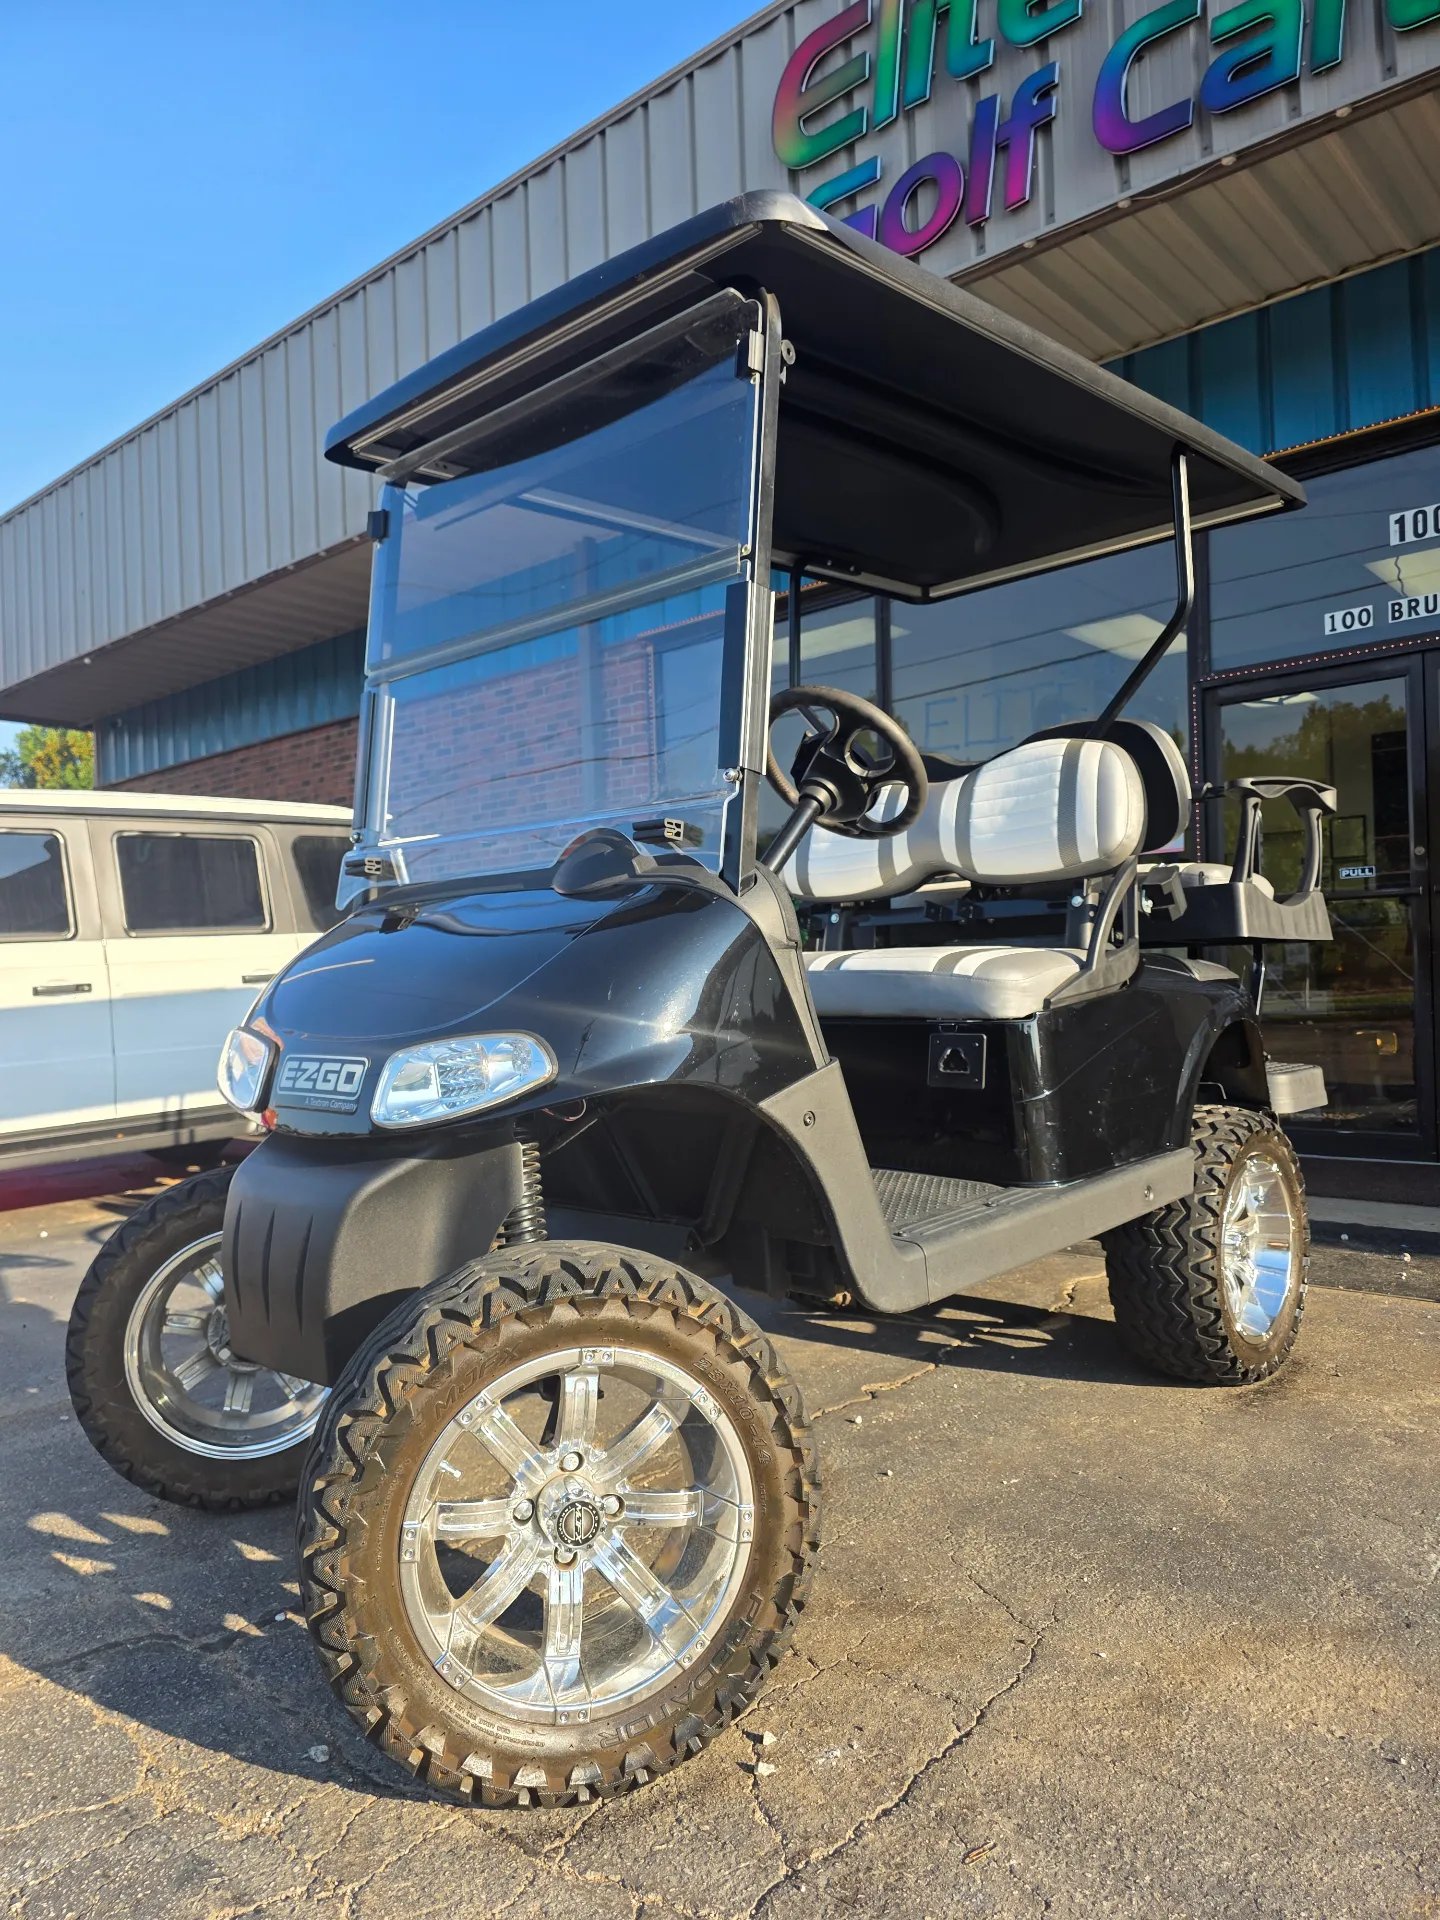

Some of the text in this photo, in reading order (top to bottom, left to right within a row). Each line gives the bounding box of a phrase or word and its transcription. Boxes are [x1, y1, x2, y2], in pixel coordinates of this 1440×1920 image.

[1328, 607, 1372, 633] 100
[1341, 867, 1374, 877] PULL
[330, 1099, 358, 1111] Company
